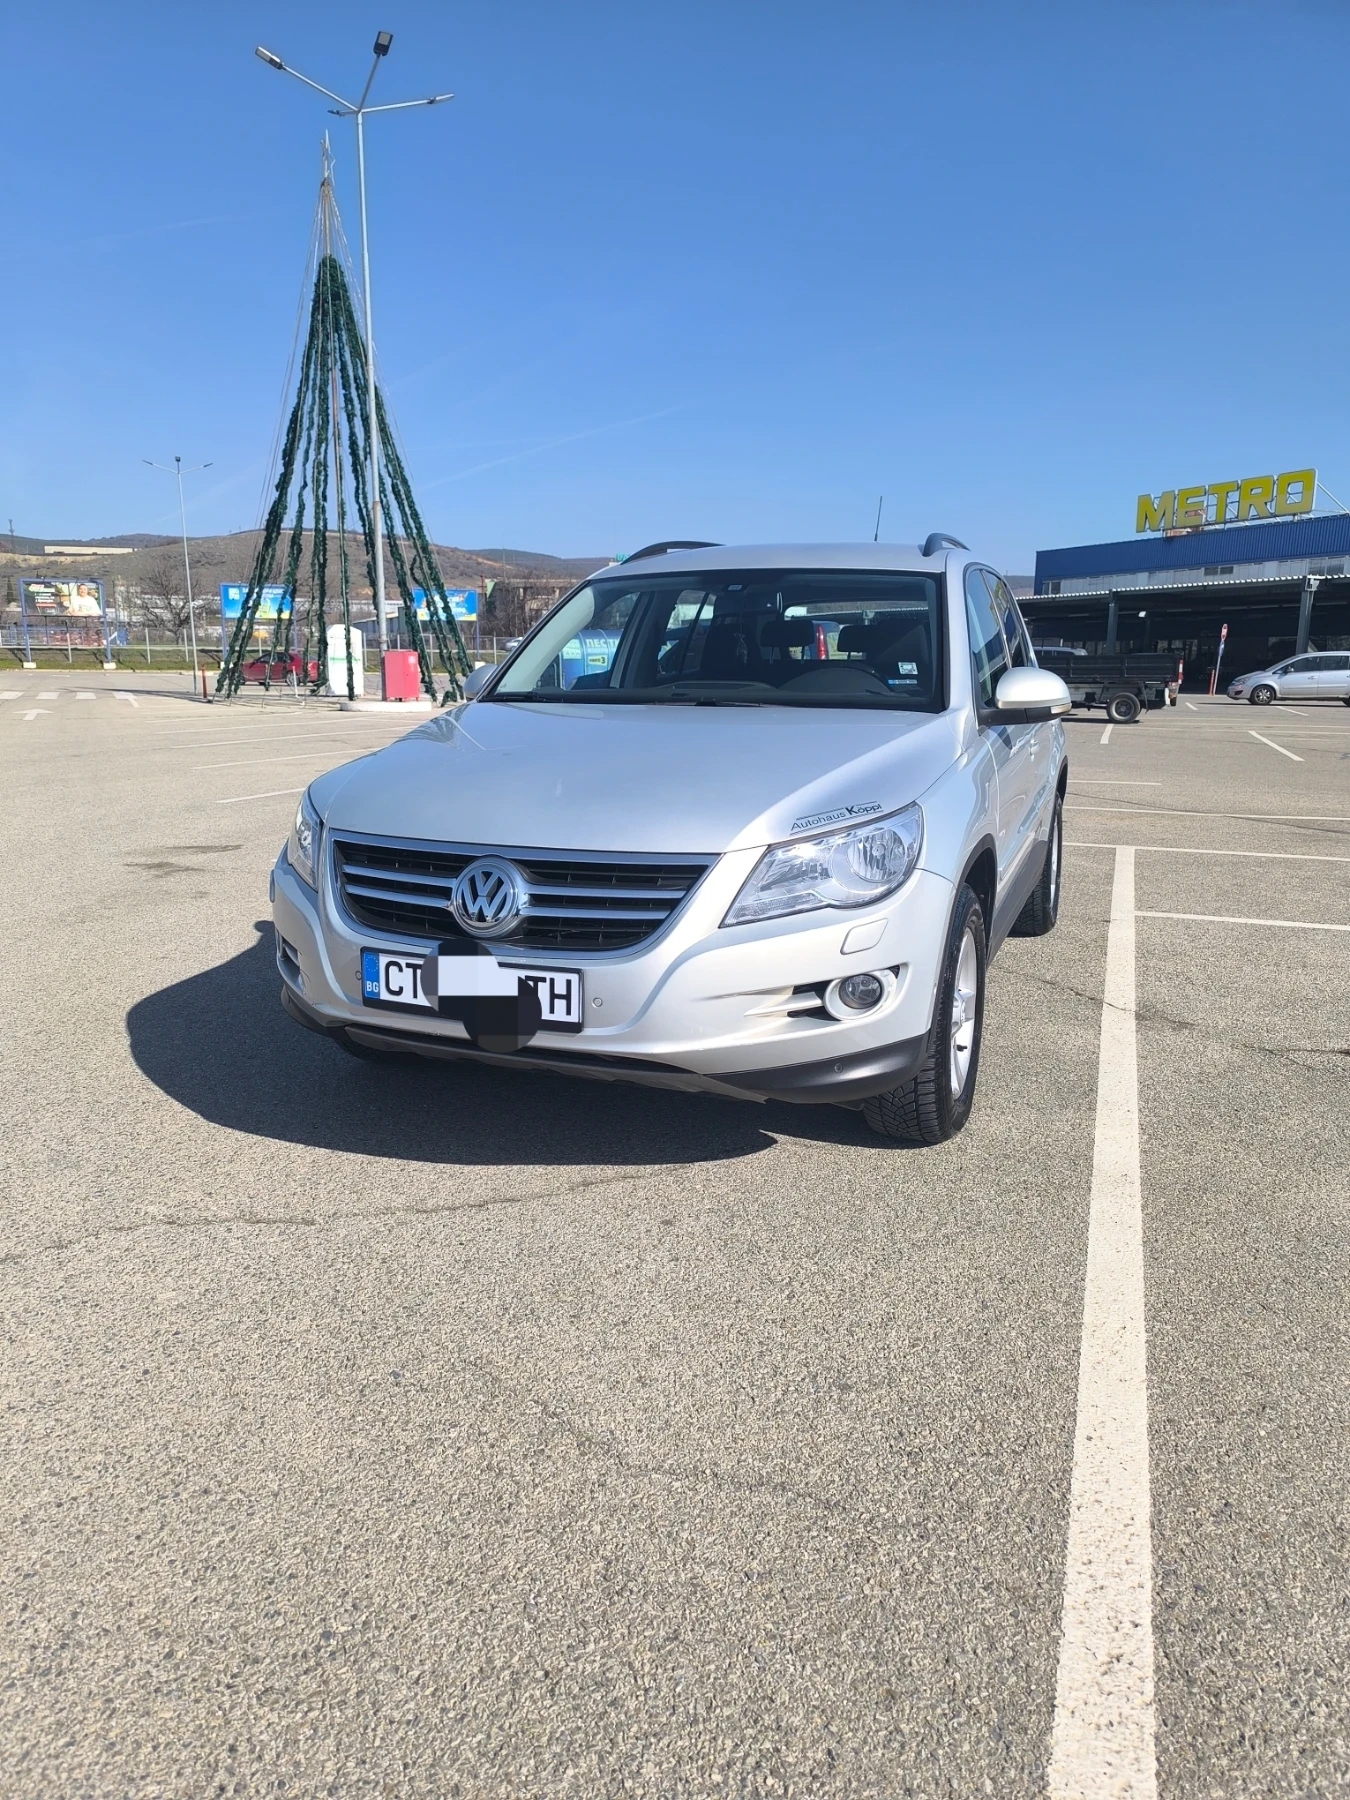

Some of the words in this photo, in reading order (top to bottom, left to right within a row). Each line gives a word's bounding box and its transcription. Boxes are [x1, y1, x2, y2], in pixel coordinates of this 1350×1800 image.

[1136, 468, 1317, 533] METRO
[790, 811, 846, 831] Autohaus
[845, 803, 882, 816] Köppl
[460, 870, 509, 922] VW
[366, 981, 379, 993] BG
